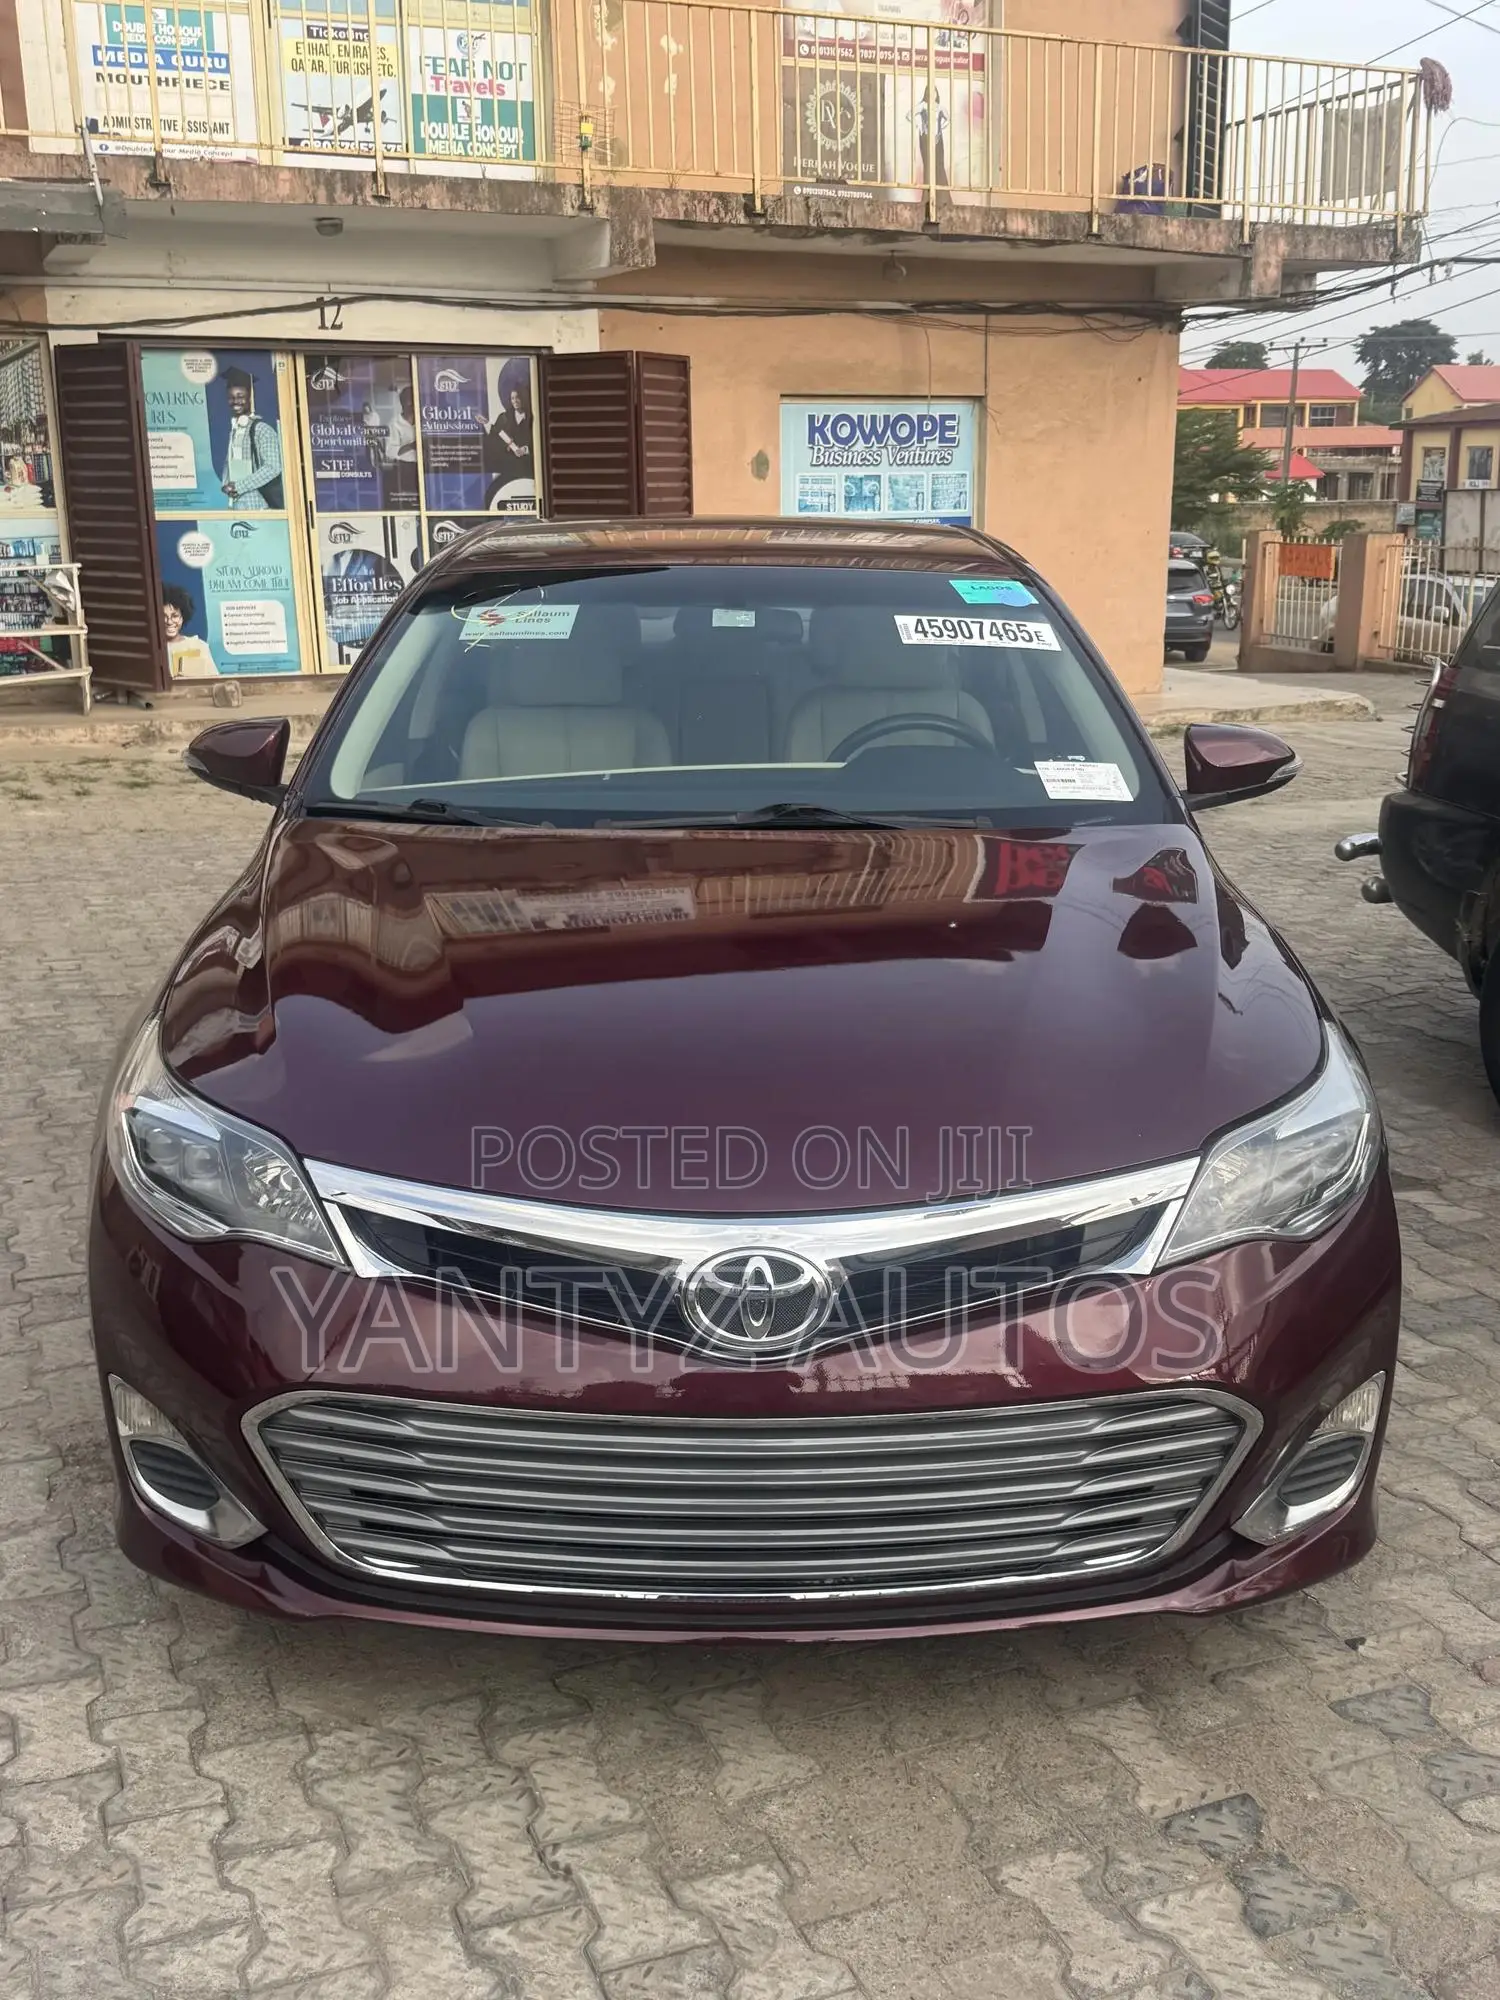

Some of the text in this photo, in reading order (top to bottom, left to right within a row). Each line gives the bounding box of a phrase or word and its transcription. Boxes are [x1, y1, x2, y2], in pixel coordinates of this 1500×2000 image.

[291, 58, 328, 75] QAAR,
[483, 60, 527, 82] NOT
[431, 76, 506, 96] Travels
[422, 405, 473, 421] Global
[311, 423, 389, 437] Global Career
[807, 413, 959, 448] KOWOPE
[811, 446, 953, 467] Business Ventures
[333, 596, 349, 605] Job
[914, 618, 1034, 643] 45907465
